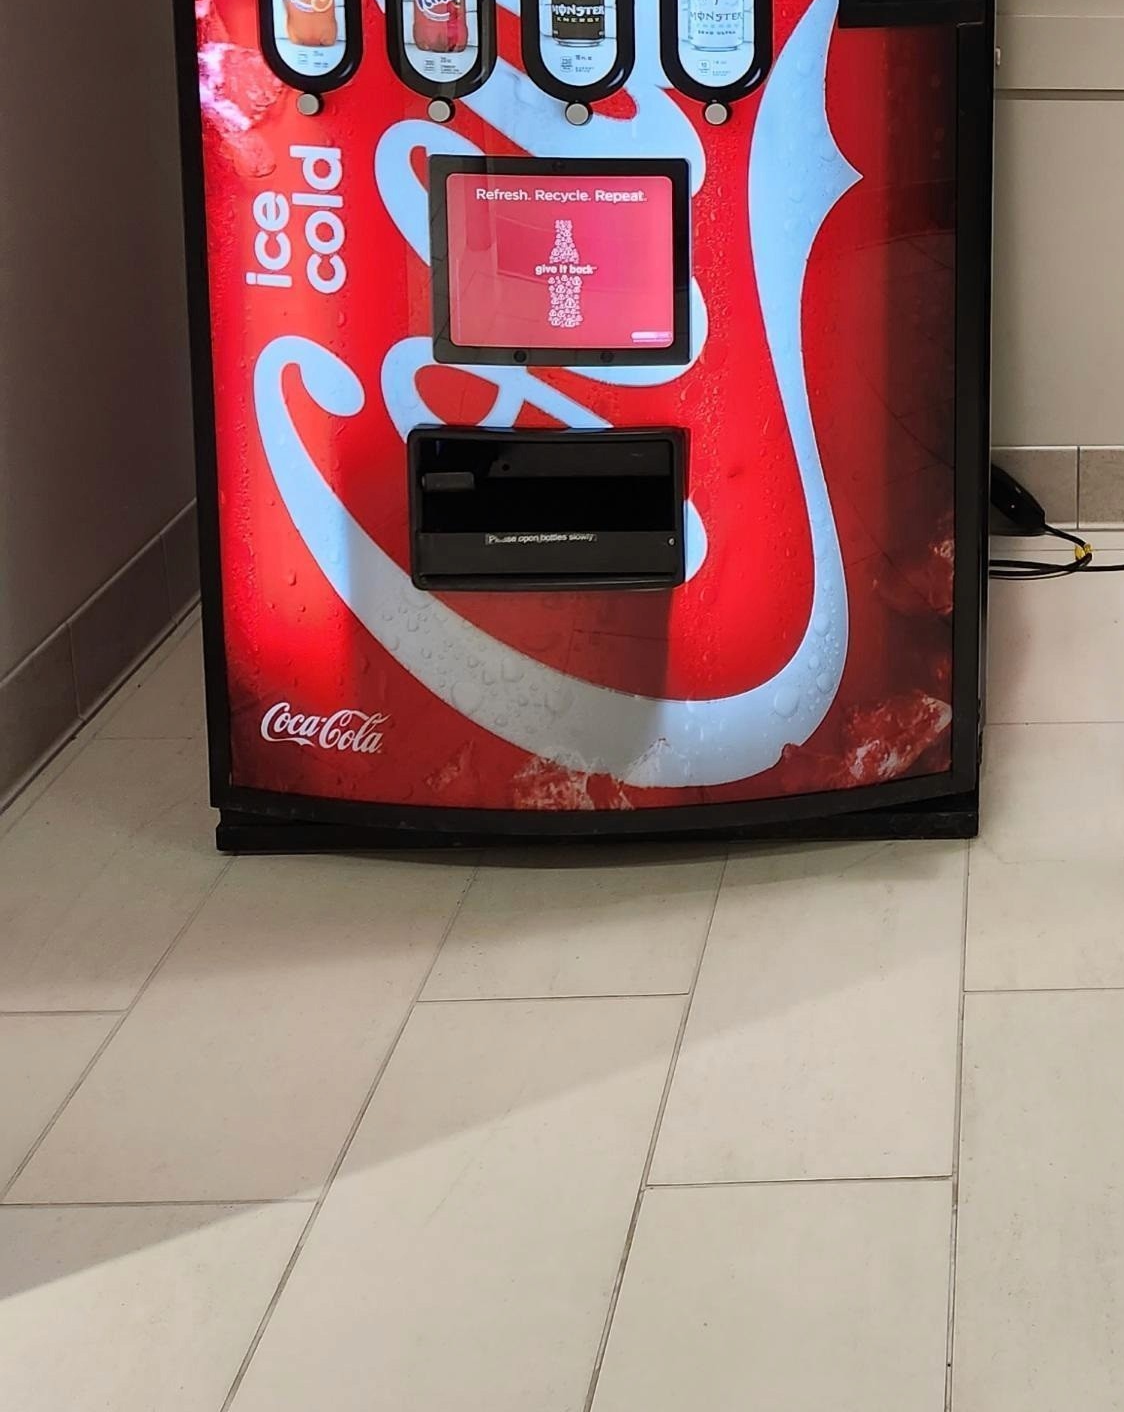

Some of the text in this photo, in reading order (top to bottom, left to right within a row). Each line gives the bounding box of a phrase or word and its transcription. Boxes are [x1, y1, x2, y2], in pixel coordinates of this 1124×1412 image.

[552, 4, 605, 16] MONSTER
[690, 11, 744, 21] MONSTER
[476, 188, 647, 204] Refresh. Recycle. Repeat.
[290, 145, 348, 294] cold
[245, 190, 294, 288] ice
[535, 263, 595, 275] give it back
[488, 534, 517, 545] Please
[540, 533, 568, 542] bottles
[569, 533, 594, 542] slowly
[260, 701, 392, 755] Coca-Cola
